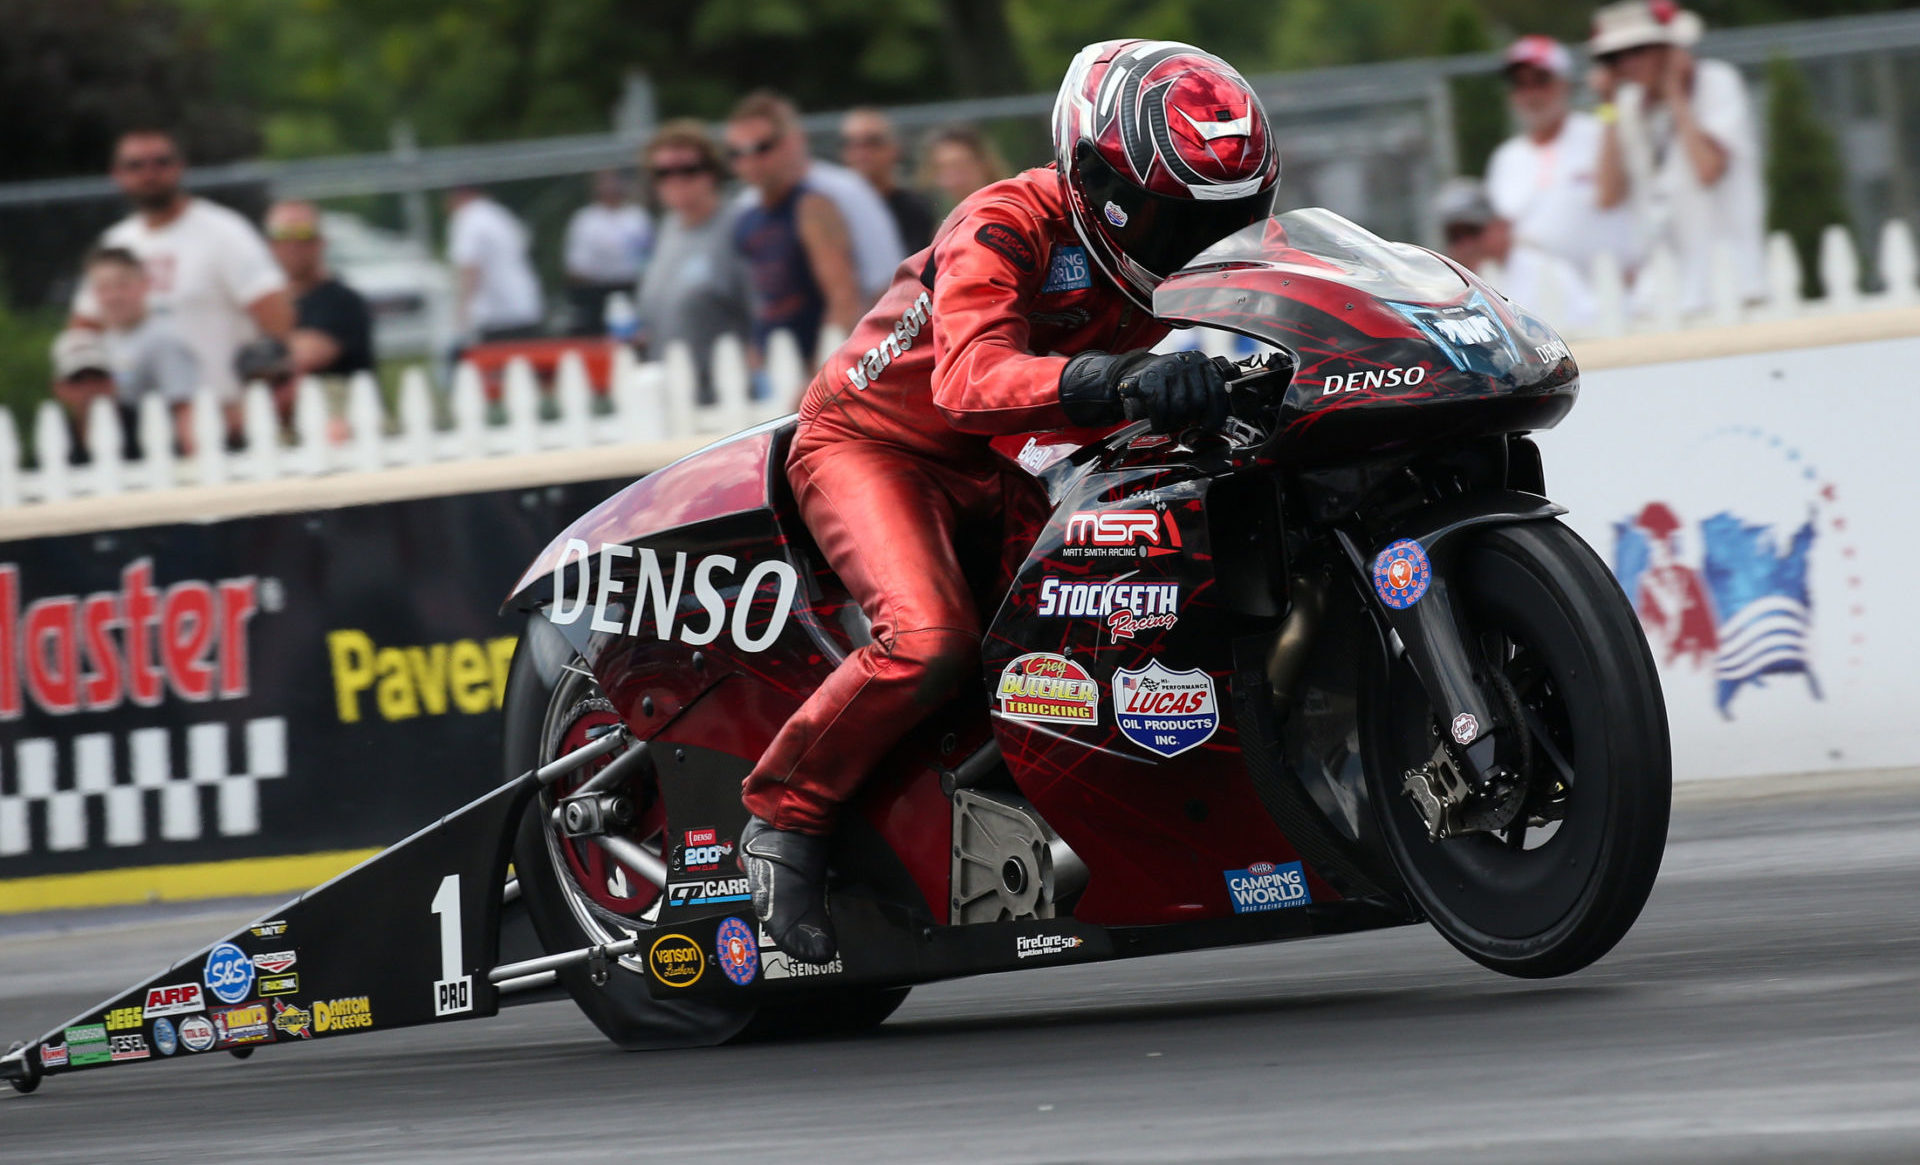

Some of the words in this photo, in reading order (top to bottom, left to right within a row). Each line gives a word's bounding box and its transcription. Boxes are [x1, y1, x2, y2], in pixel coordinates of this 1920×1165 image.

[846, 291, 933, 391] vanson
[1322, 366, 1425, 396] DENSO
[1065, 511, 1160, 544] MSR
[1063, 548, 1083, 557] MATT
[1084, 548, 1107, 557] SMITH
[1108, 548, 1137, 557] RACING
[550, 538, 798, 653] DENSO
[1107, 608, 1178, 644] Racing
[1025, 656, 1067, 678] Greg
[1002, 674, 1095, 701] BUTCHER
[1008, 701, 1091, 718] TRUCKING
[1126, 691, 1207, 714] LUCAS
[1122, 719, 1142, 730] OIL
[1144, 718, 1213, 730] PRODUCTS
[693, 833, 713, 842] DENSO
[684, 846, 720, 866] 200
[1251, 863, 1274, 873] NHRA
[1230, 870, 1301, 891] CAMPING
[1233, 883, 1305, 905] WORLD
[431, 874, 463, 980] 1
[1016, 934, 1061, 950] FireCore
[655, 948, 698, 963] vanson
[209, 958, 246, 986] S&S
[148, 986, 199, 1008] ARP
[440, 981, 468, 1012] PRO
[330, 1013, 373, 1030] SLEEVES
